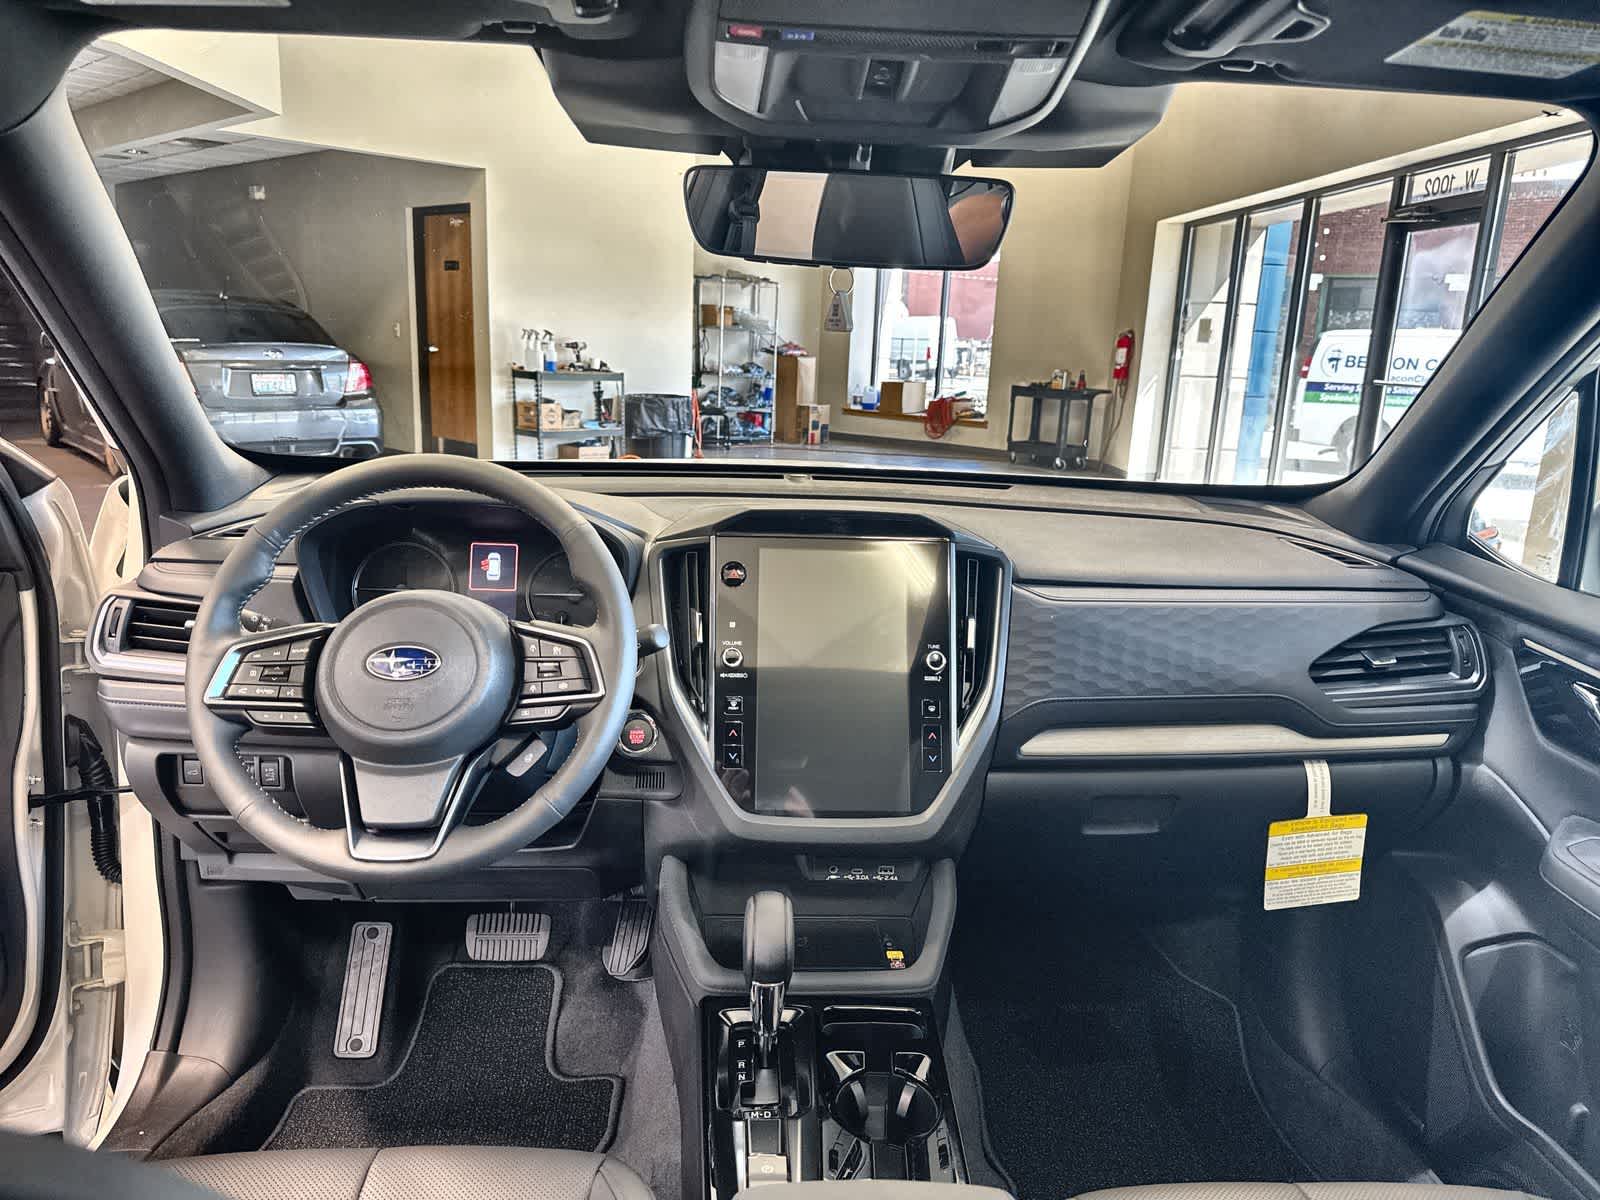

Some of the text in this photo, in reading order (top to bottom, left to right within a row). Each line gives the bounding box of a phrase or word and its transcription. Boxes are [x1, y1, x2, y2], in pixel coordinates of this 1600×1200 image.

[1344, 355, 1419, 371] BEON
[738, 1061, 745, 1069] R
[738, 1073, 746, 1081] N
